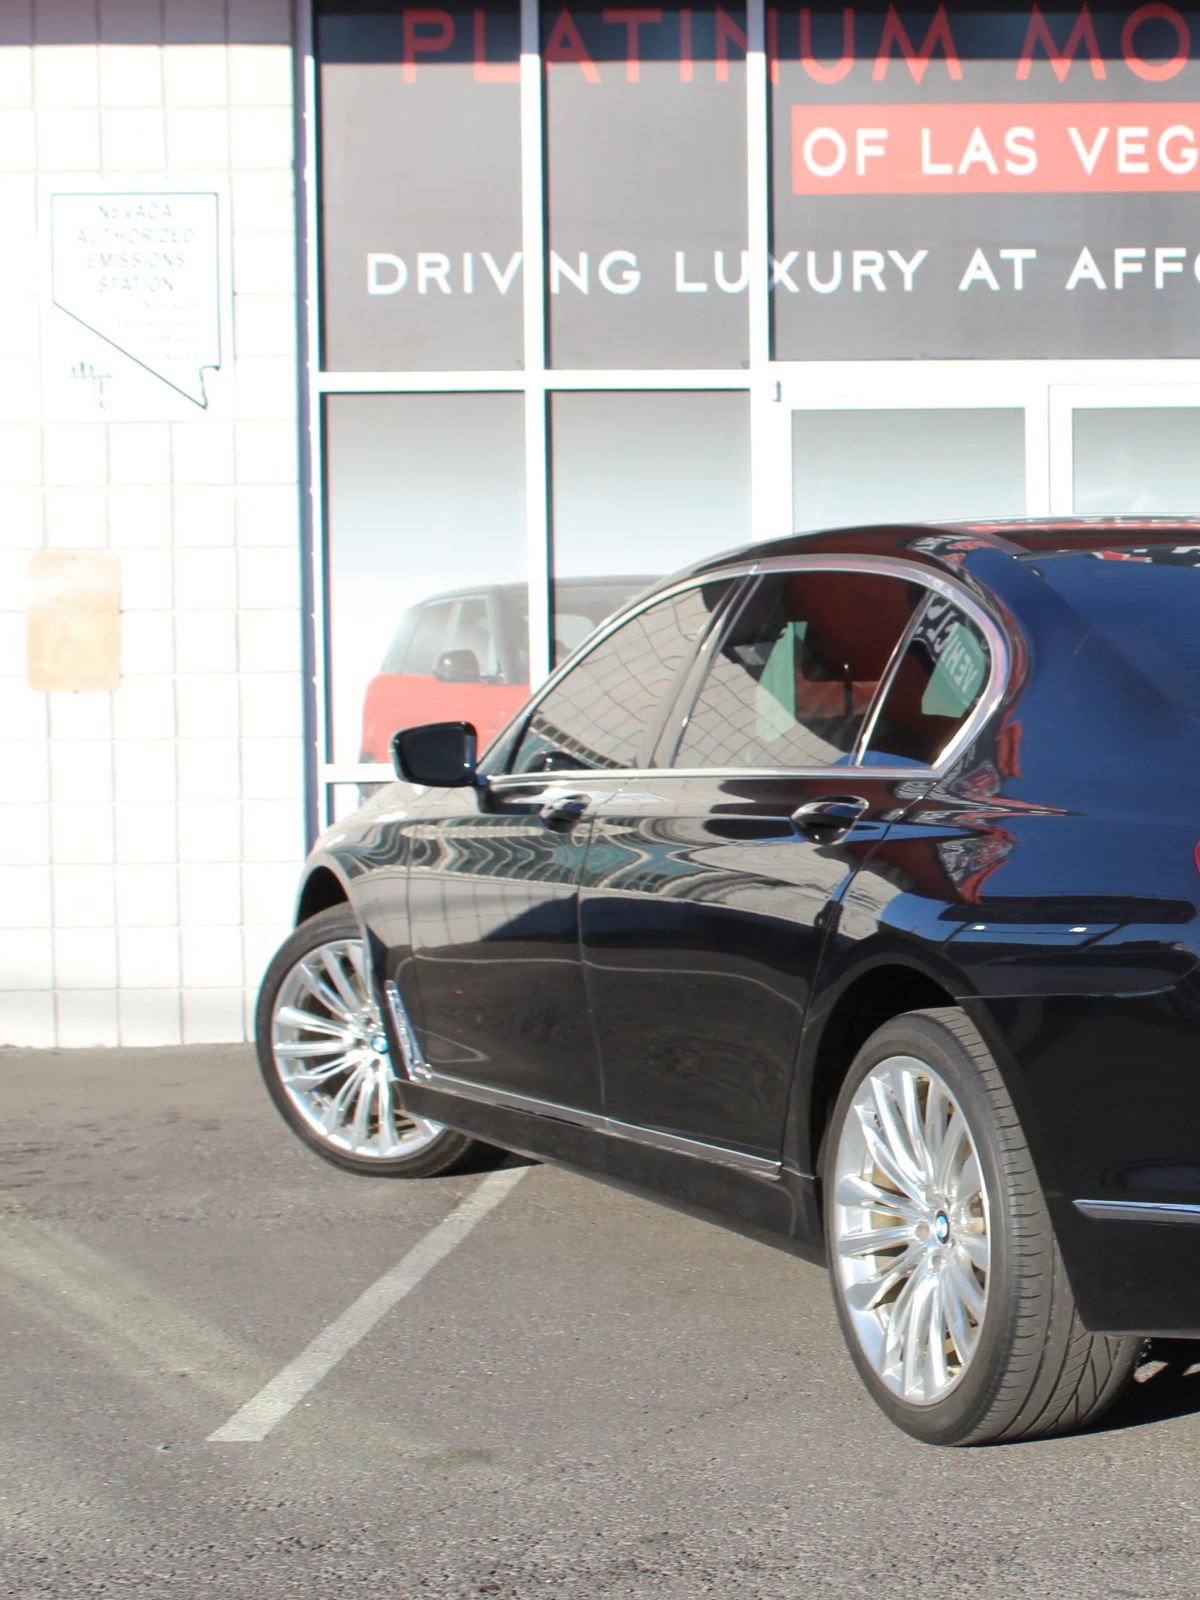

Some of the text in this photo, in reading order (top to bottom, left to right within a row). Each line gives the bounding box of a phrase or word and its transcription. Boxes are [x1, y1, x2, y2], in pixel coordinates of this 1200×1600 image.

[404, 4, 964, 85] PLATINUM
[803, 127, 889, 177] OF
[921, 126, 1038, 176] LAS
[367, 250, 642, 295] DRIVNG
[675, 250, 928, 293] LUXURY
[959, 248, 1037, 292] AT
